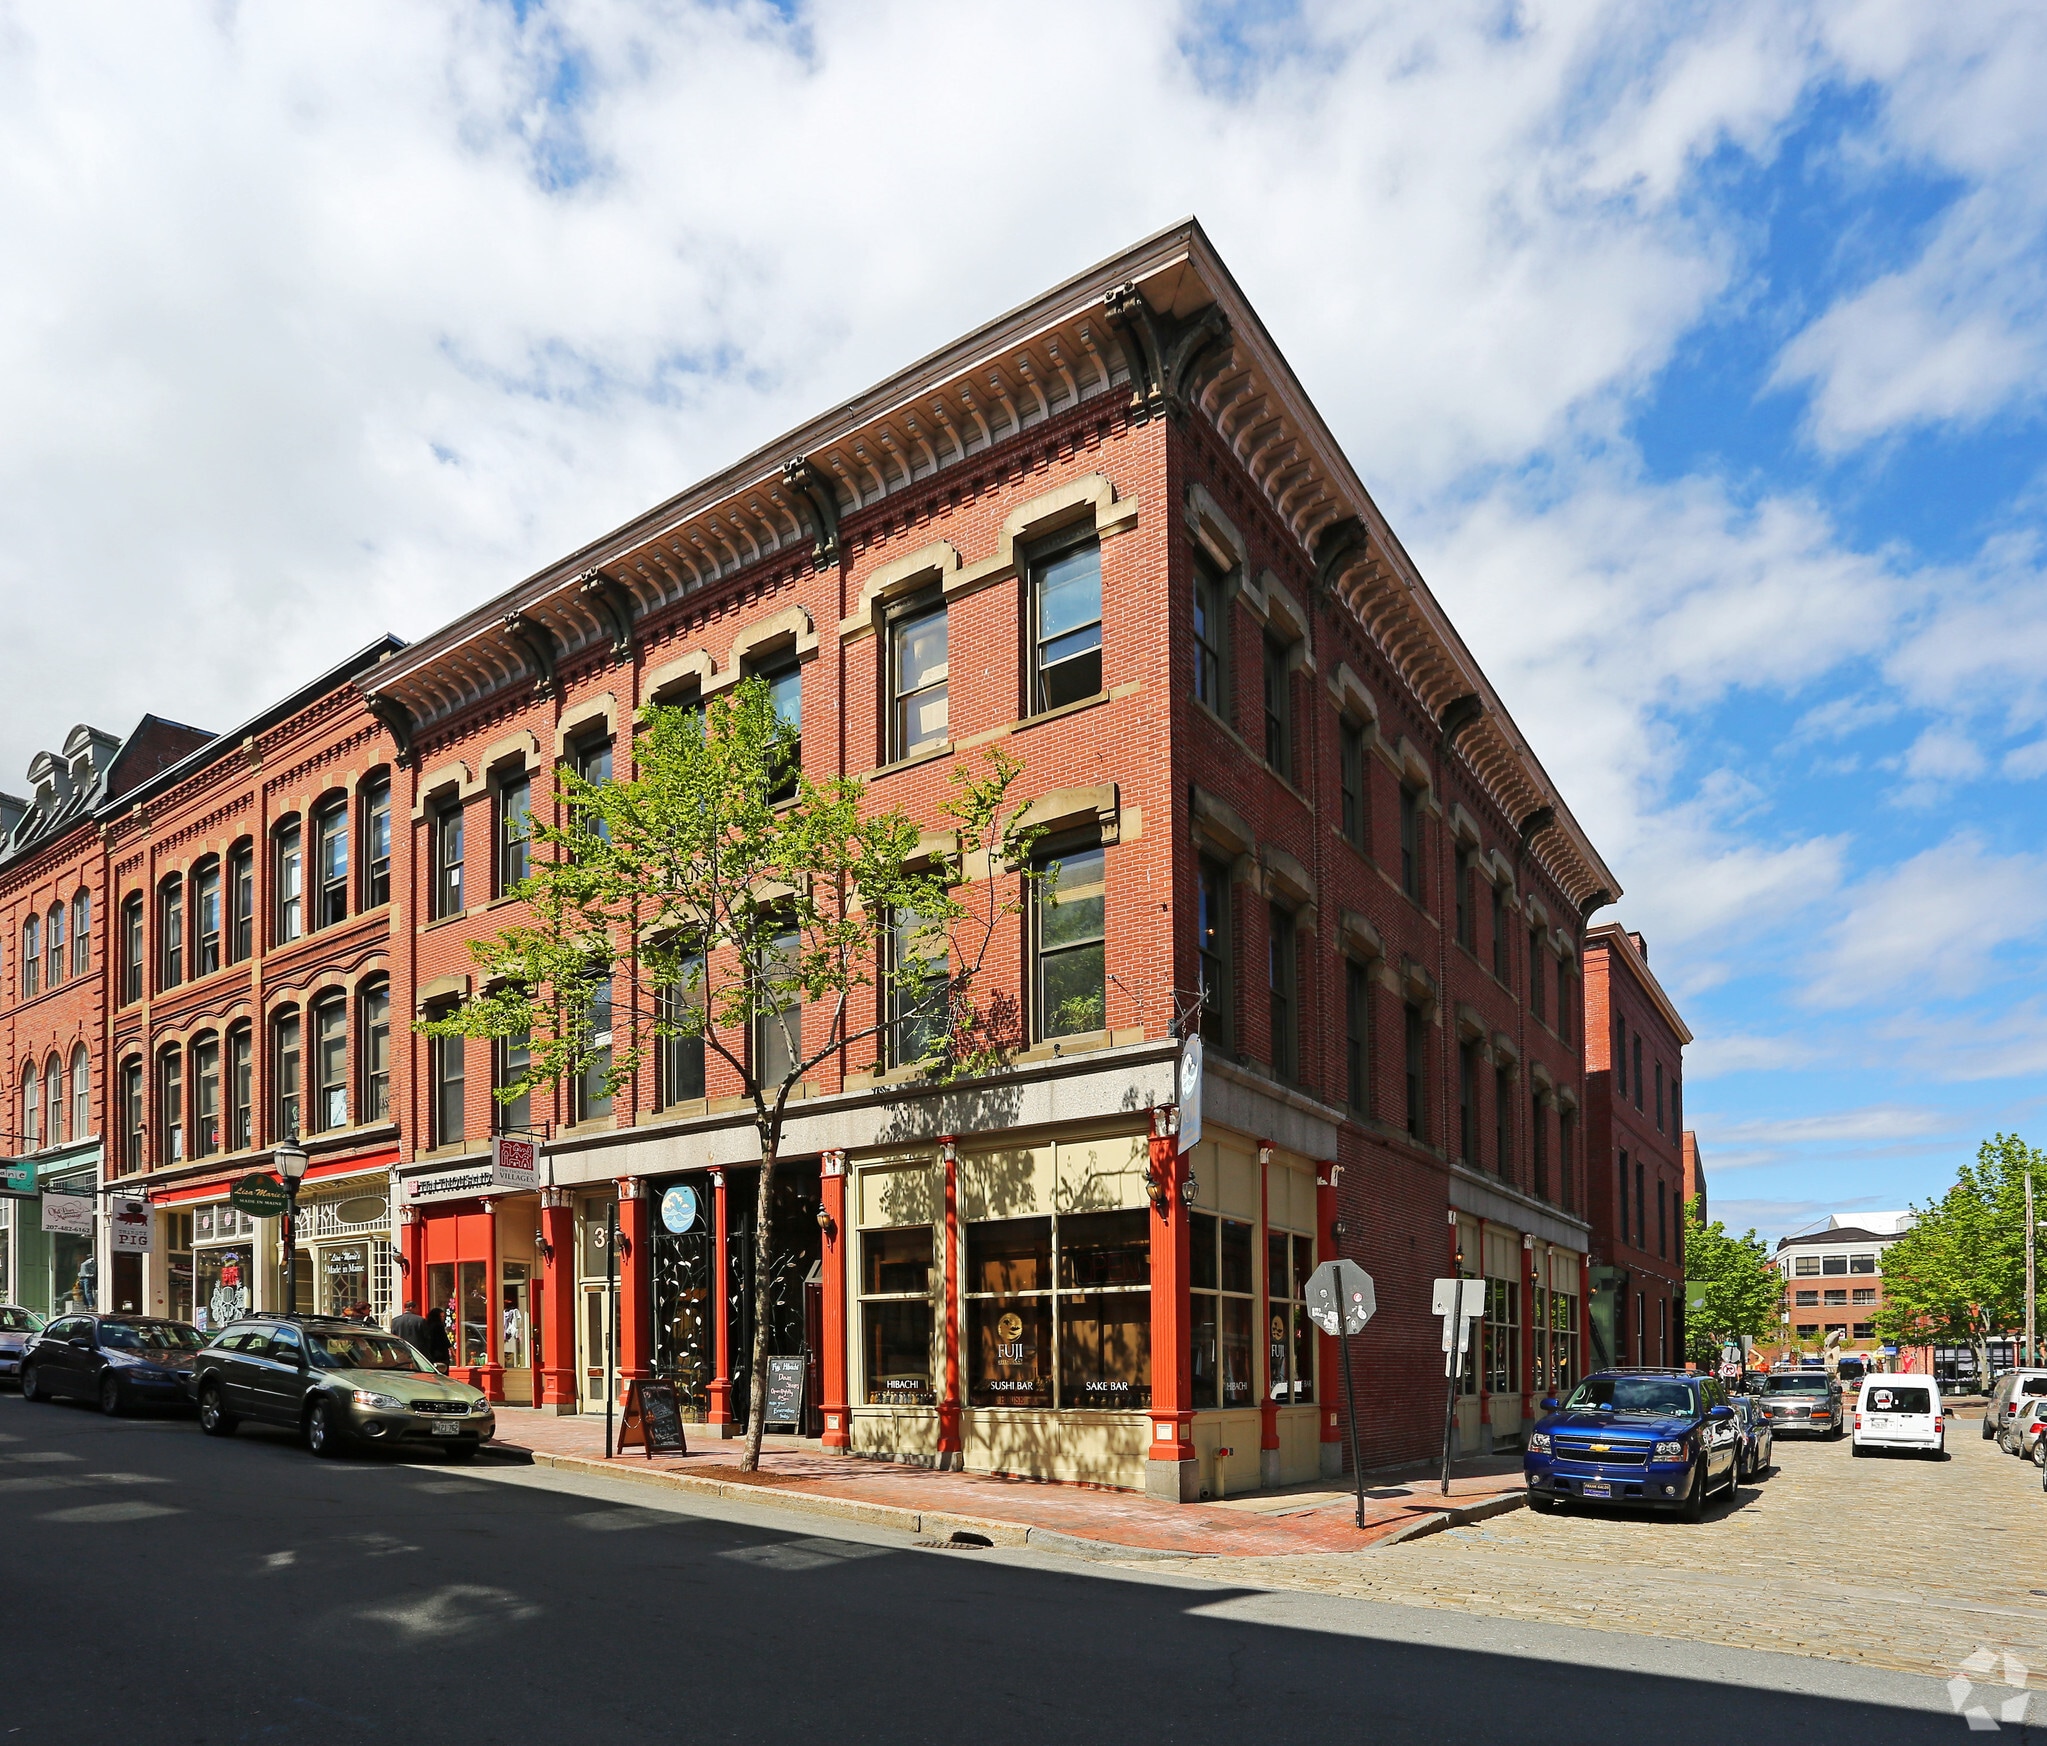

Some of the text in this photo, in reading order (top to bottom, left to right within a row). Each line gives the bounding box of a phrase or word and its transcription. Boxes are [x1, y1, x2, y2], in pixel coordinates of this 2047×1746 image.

[500, 1172, 535, 1182] VILLAGES
[234, 1187, 253, 1196] Lisa
[118, 1234, 148, 1246] PIG
[998, 1343, 1023, 1360] FUJI
[1271, 1344, 1285, 1358] FUJI
[886, 1380, 919, 1389] HIBACHI
[990, 1381, 1034, 1391] SUSHI BAR
[1085, 1381, 1129, 1391] SAKE BAR
[1226, 1381, 1248, 1391] HIBACHI
